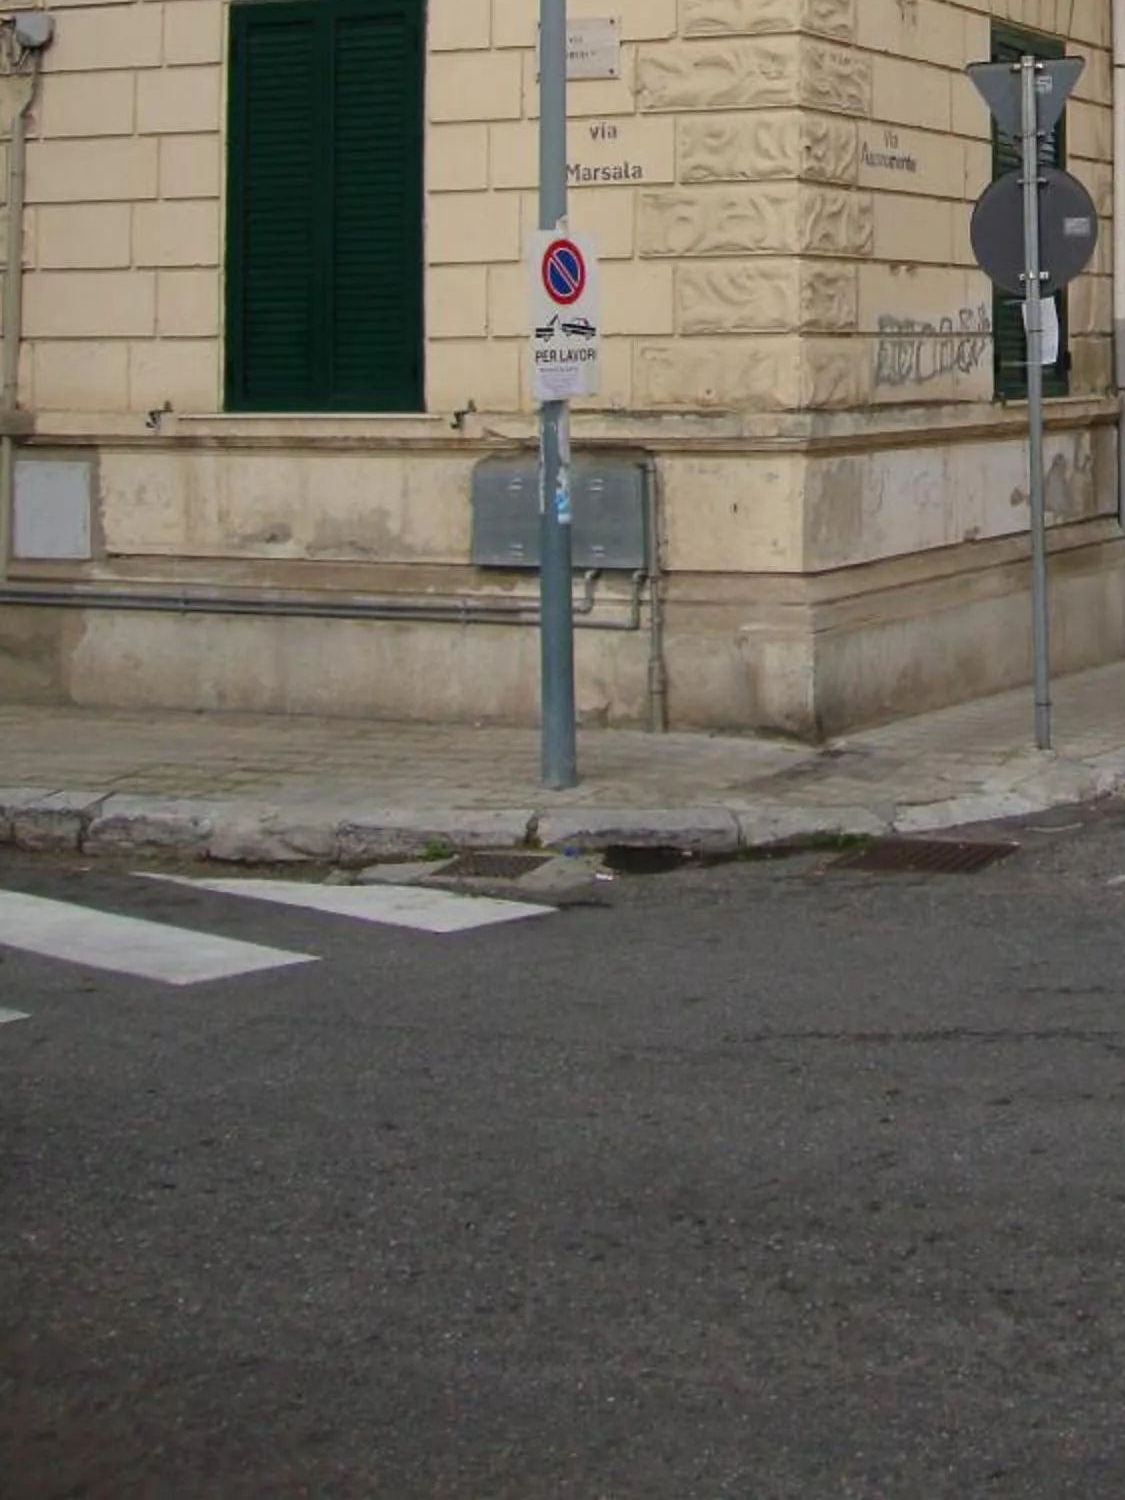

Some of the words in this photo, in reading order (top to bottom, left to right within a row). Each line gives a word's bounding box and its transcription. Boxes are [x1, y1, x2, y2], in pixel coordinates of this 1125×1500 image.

[589, 122, 617, 140] via
[565, 161, 643, 182] Marsala
[535, 349, 557, 363] PER
[560, 347, 597, 363] LAVORI
